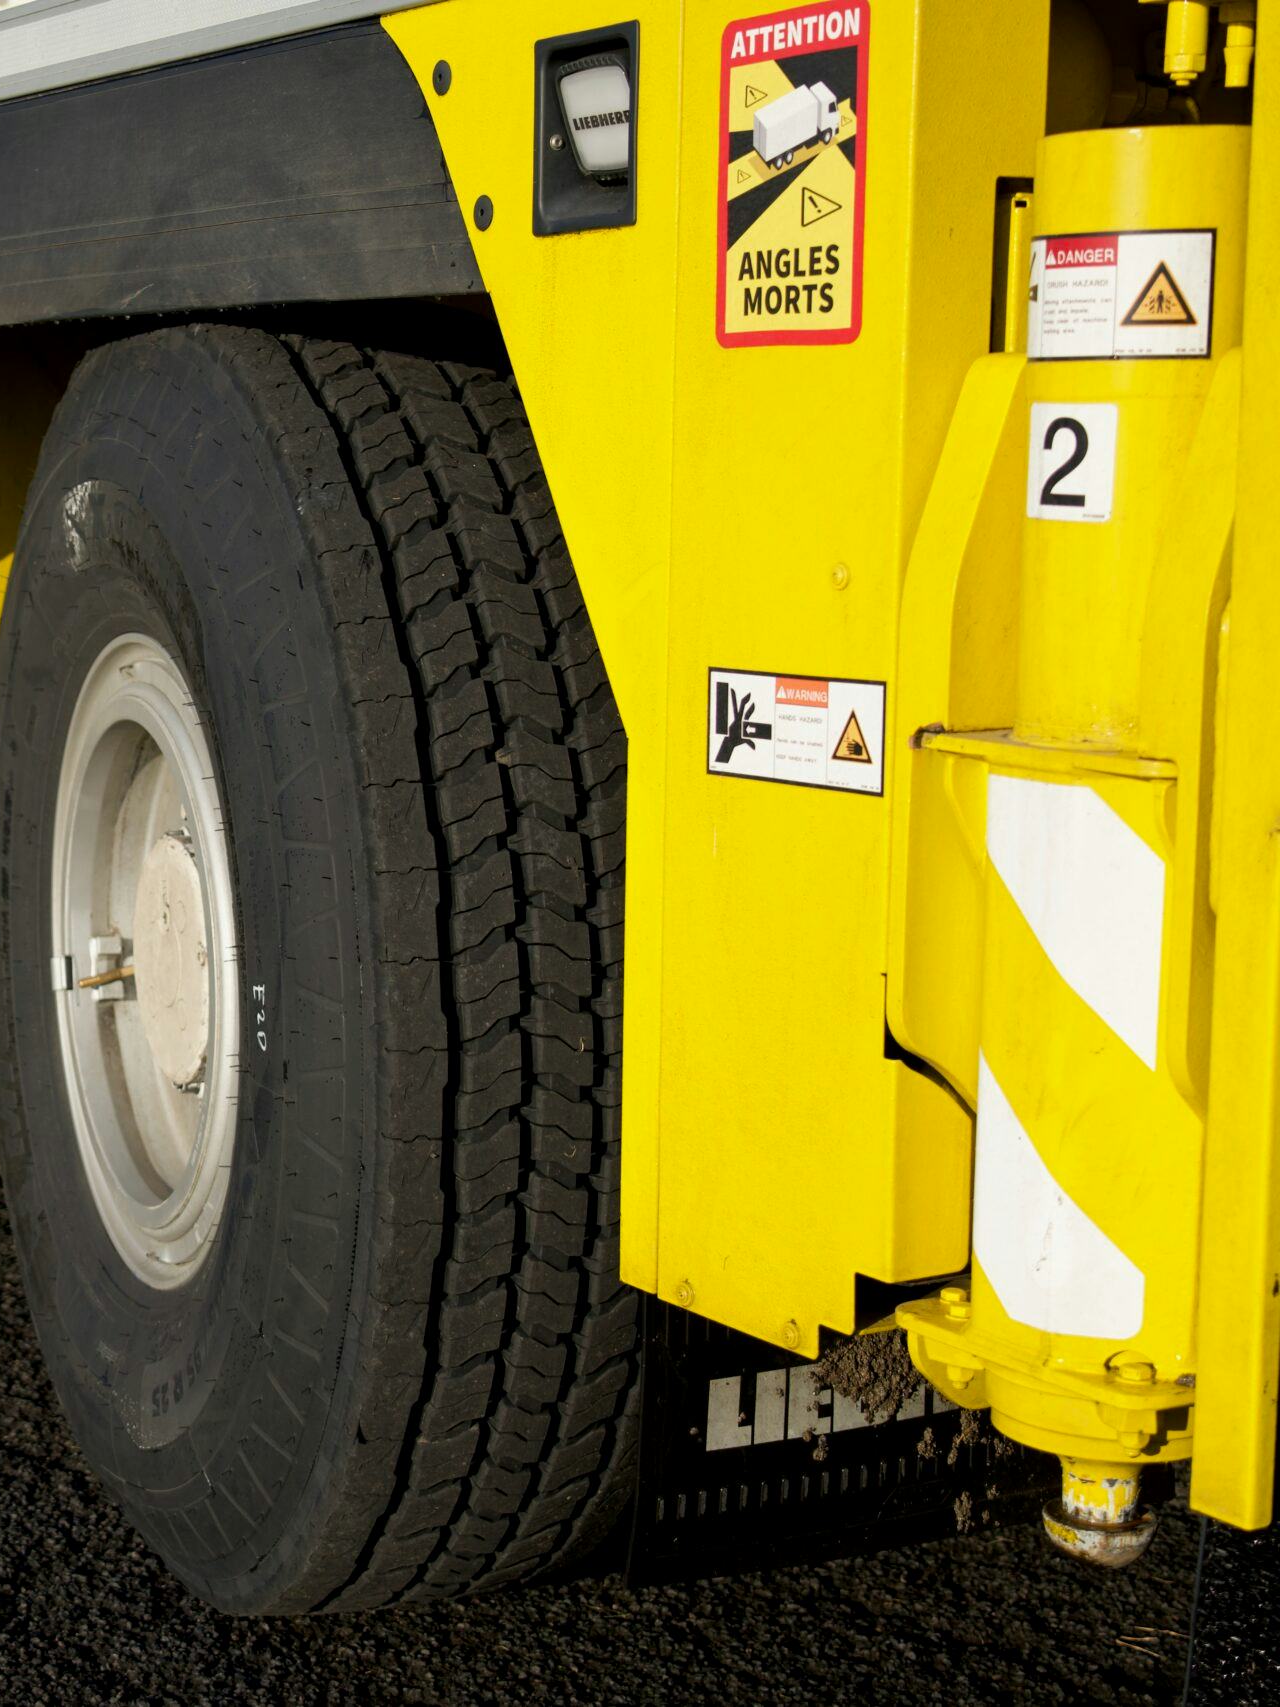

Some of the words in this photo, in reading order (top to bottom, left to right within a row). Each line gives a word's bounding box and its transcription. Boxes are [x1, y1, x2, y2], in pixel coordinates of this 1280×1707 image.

[730, 7, 861, 59] ATTENTION
[738, 243, 840, 281] ANGLES
[1057, 247, 1115, 265] DANGER
[743, 282, 834, 316] MORTS
[1040, 416, 1089, 508] 2
[786, 688, 828, 703] WARNING
